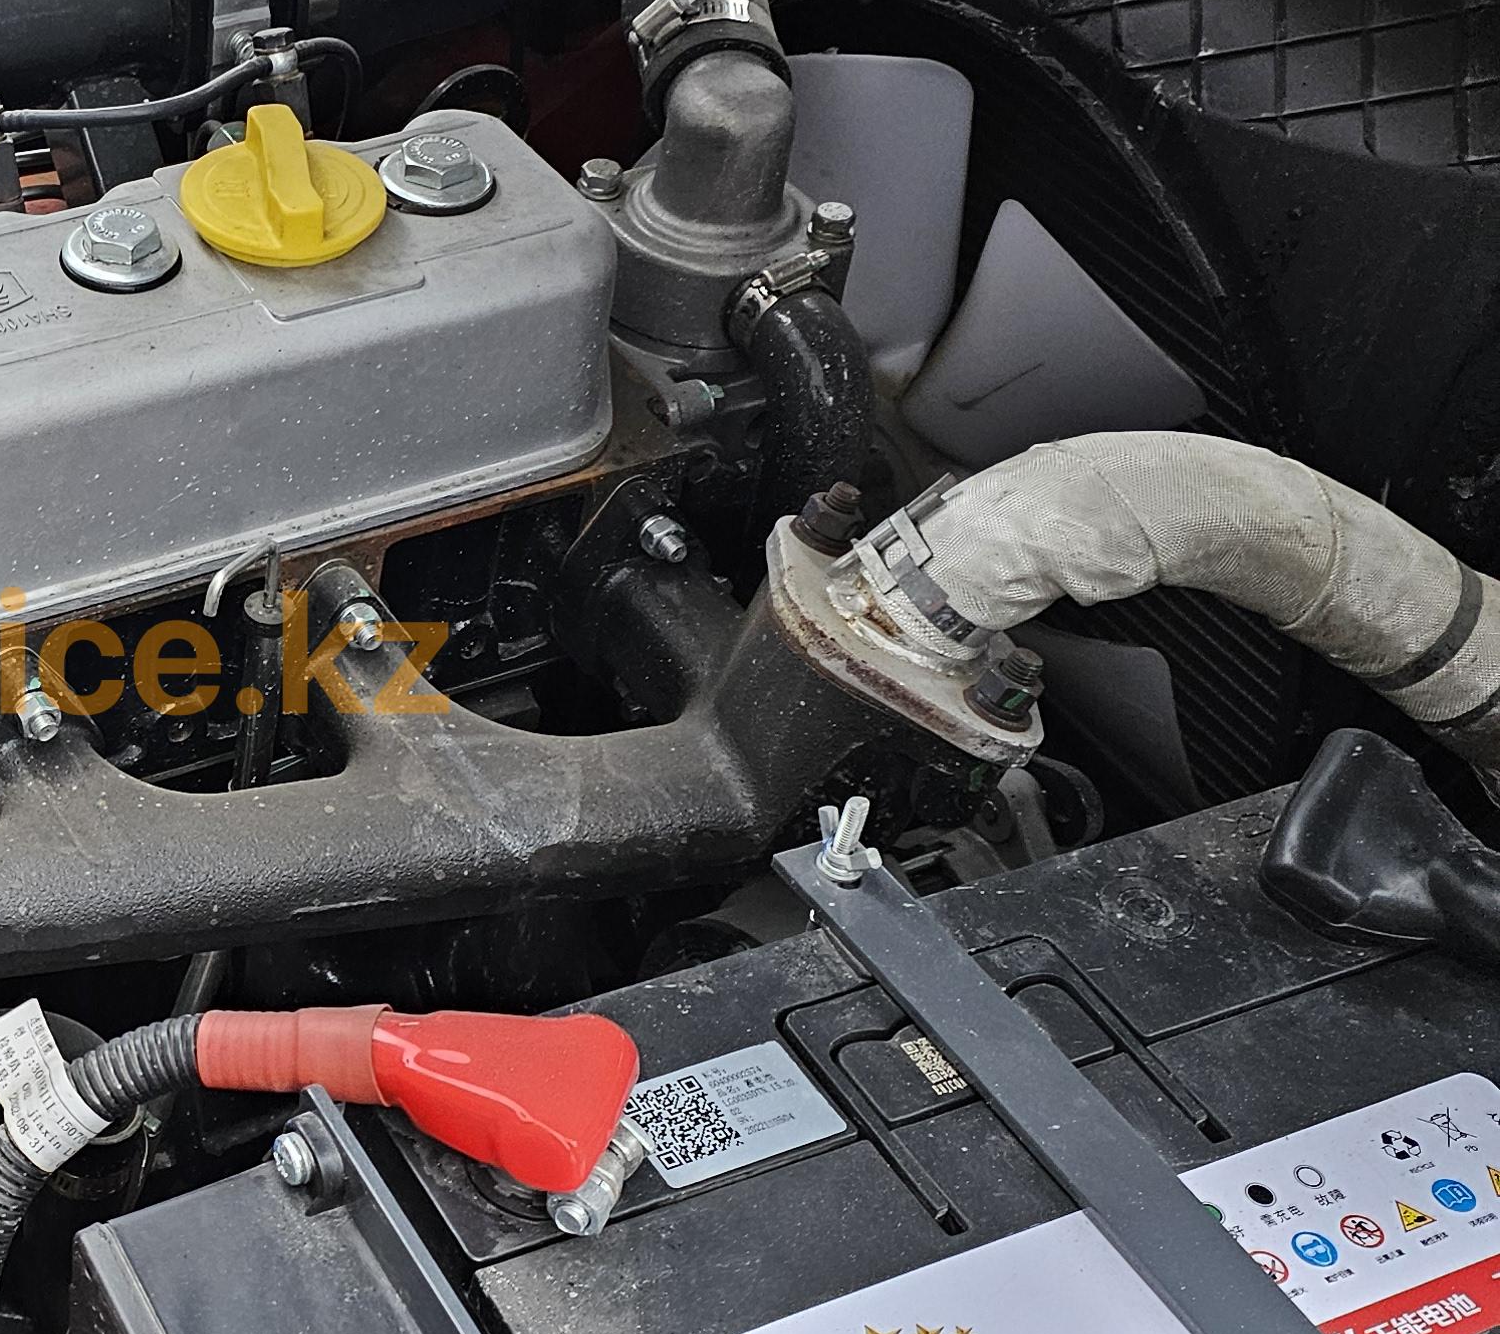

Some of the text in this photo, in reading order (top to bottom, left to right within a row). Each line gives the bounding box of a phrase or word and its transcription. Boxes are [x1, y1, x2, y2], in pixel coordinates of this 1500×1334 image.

[1314, 1190, 1347, 1207] 故障
[1259, 1205, 1304, 1228] 需充电
